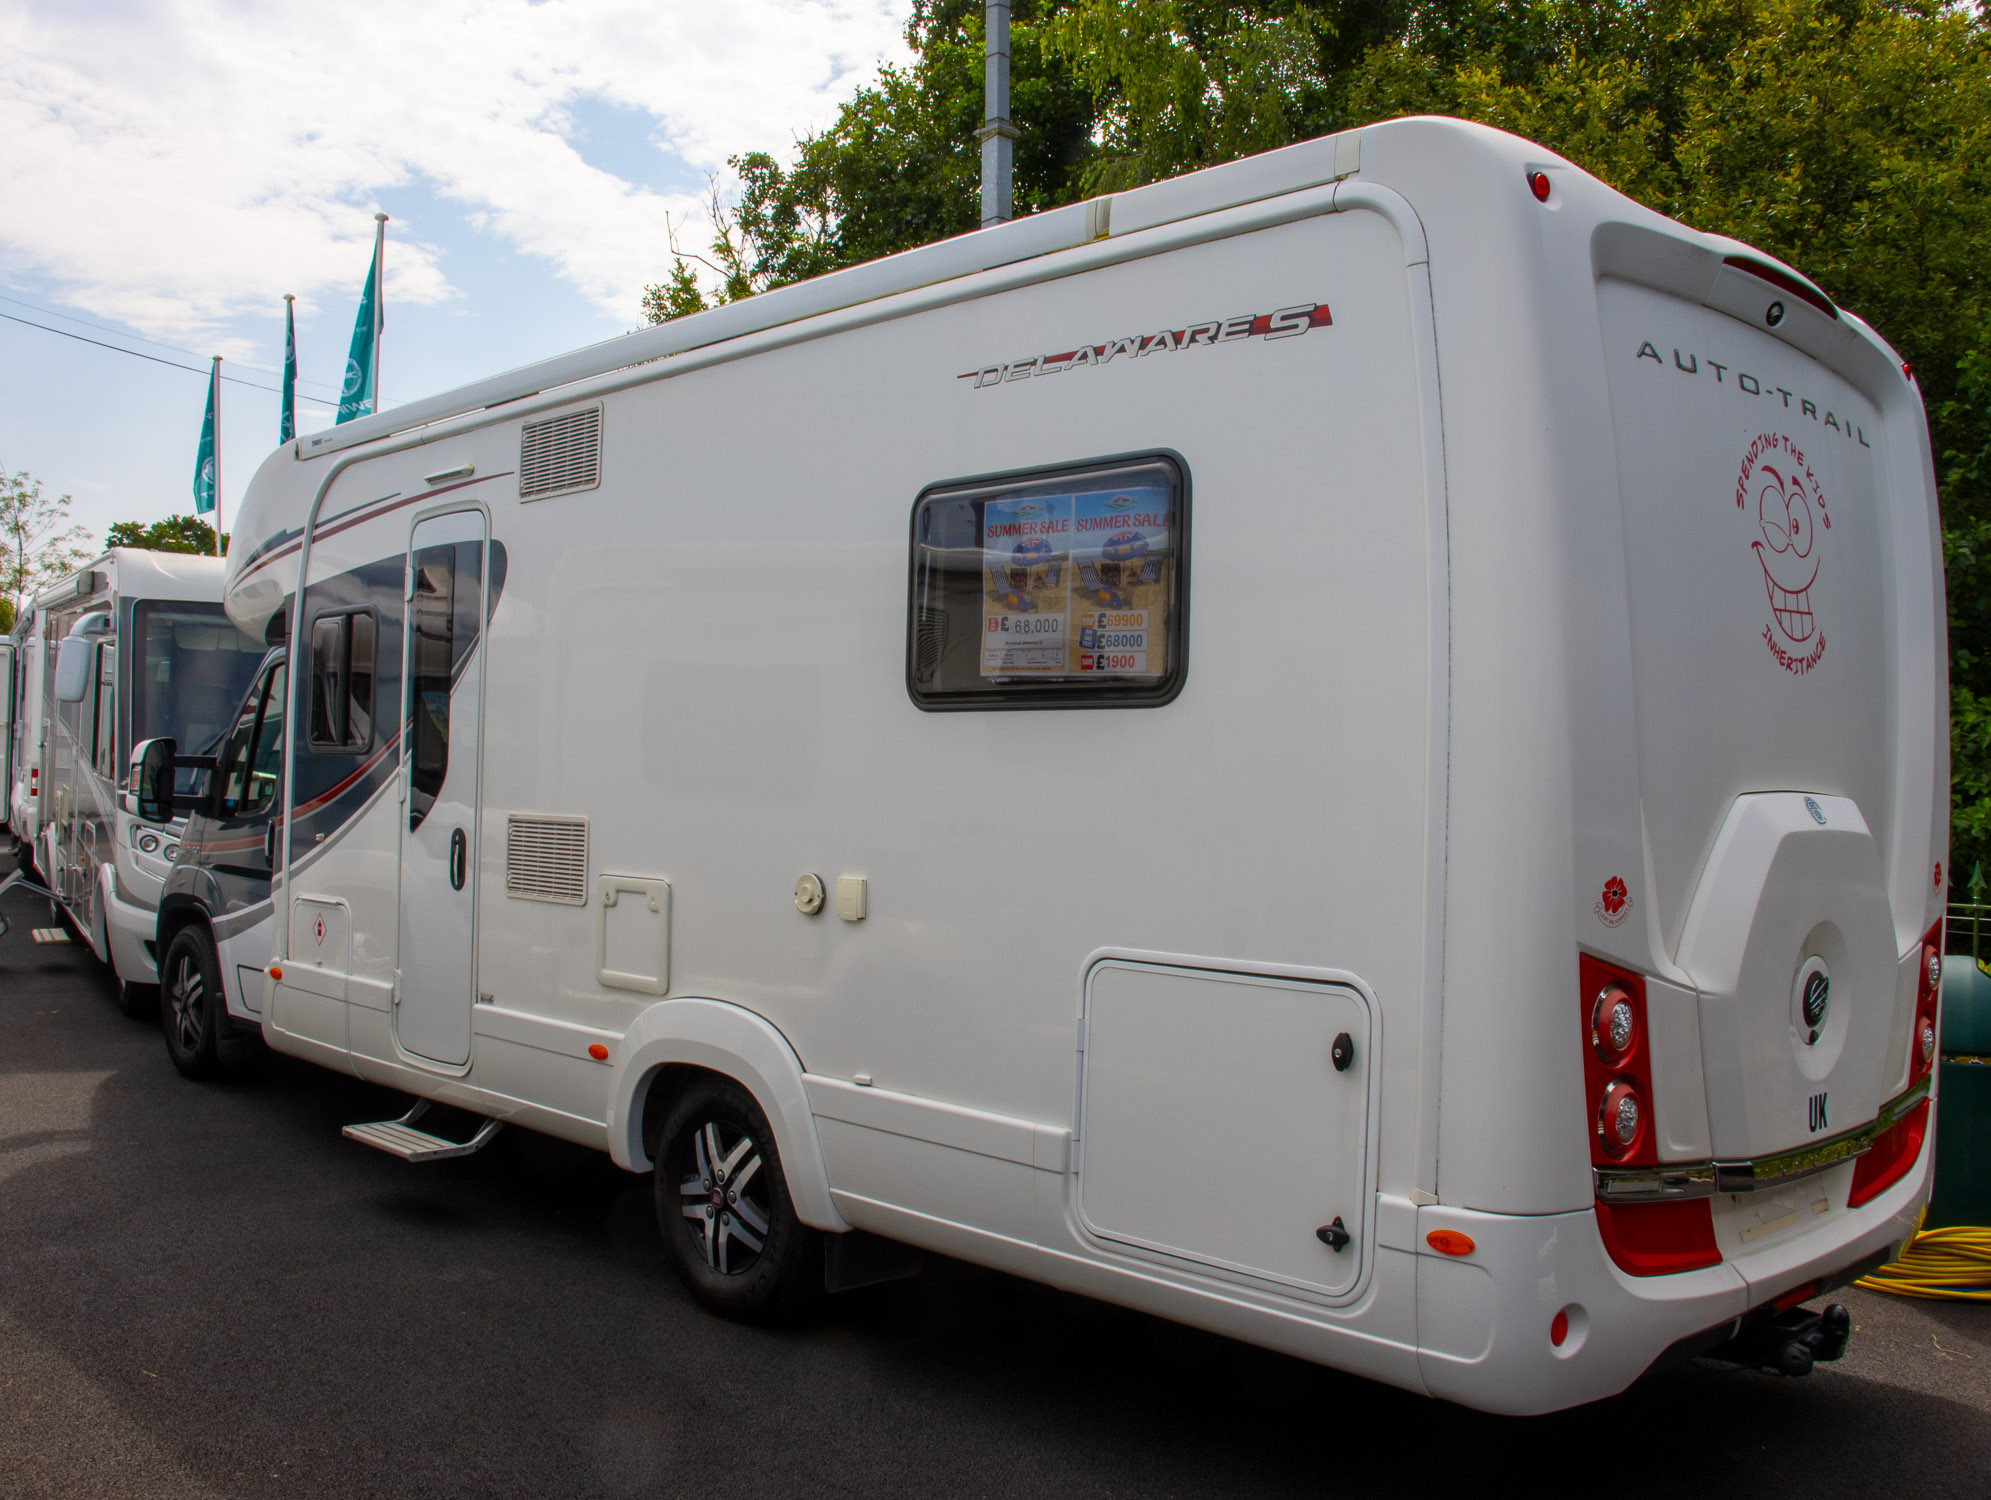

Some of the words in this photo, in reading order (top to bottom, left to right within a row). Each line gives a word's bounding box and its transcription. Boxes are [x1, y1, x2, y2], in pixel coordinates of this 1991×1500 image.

[973, 313, 1256, 389] DELAWARE
[1264, 303, 1317, 341] S
[1636, 340, 1870, 449] AUTO-TRAIL
[1736, 431, 1779, 511] SPENDING
[1782, 435, 1804, 467] THE
[1805, 465, 1832, 530] KIDS
[987, 521, 1038, 539] SUMMER
[1040, 518, 1069, 535] SALE
[1076, 514, 1131, 532] SUMMER
[1015, 618, 1059, 634] 68,000
[1761, 623, 1826, 675] INHERITANCE
[1808, 1091, 1828, 1133] UK
